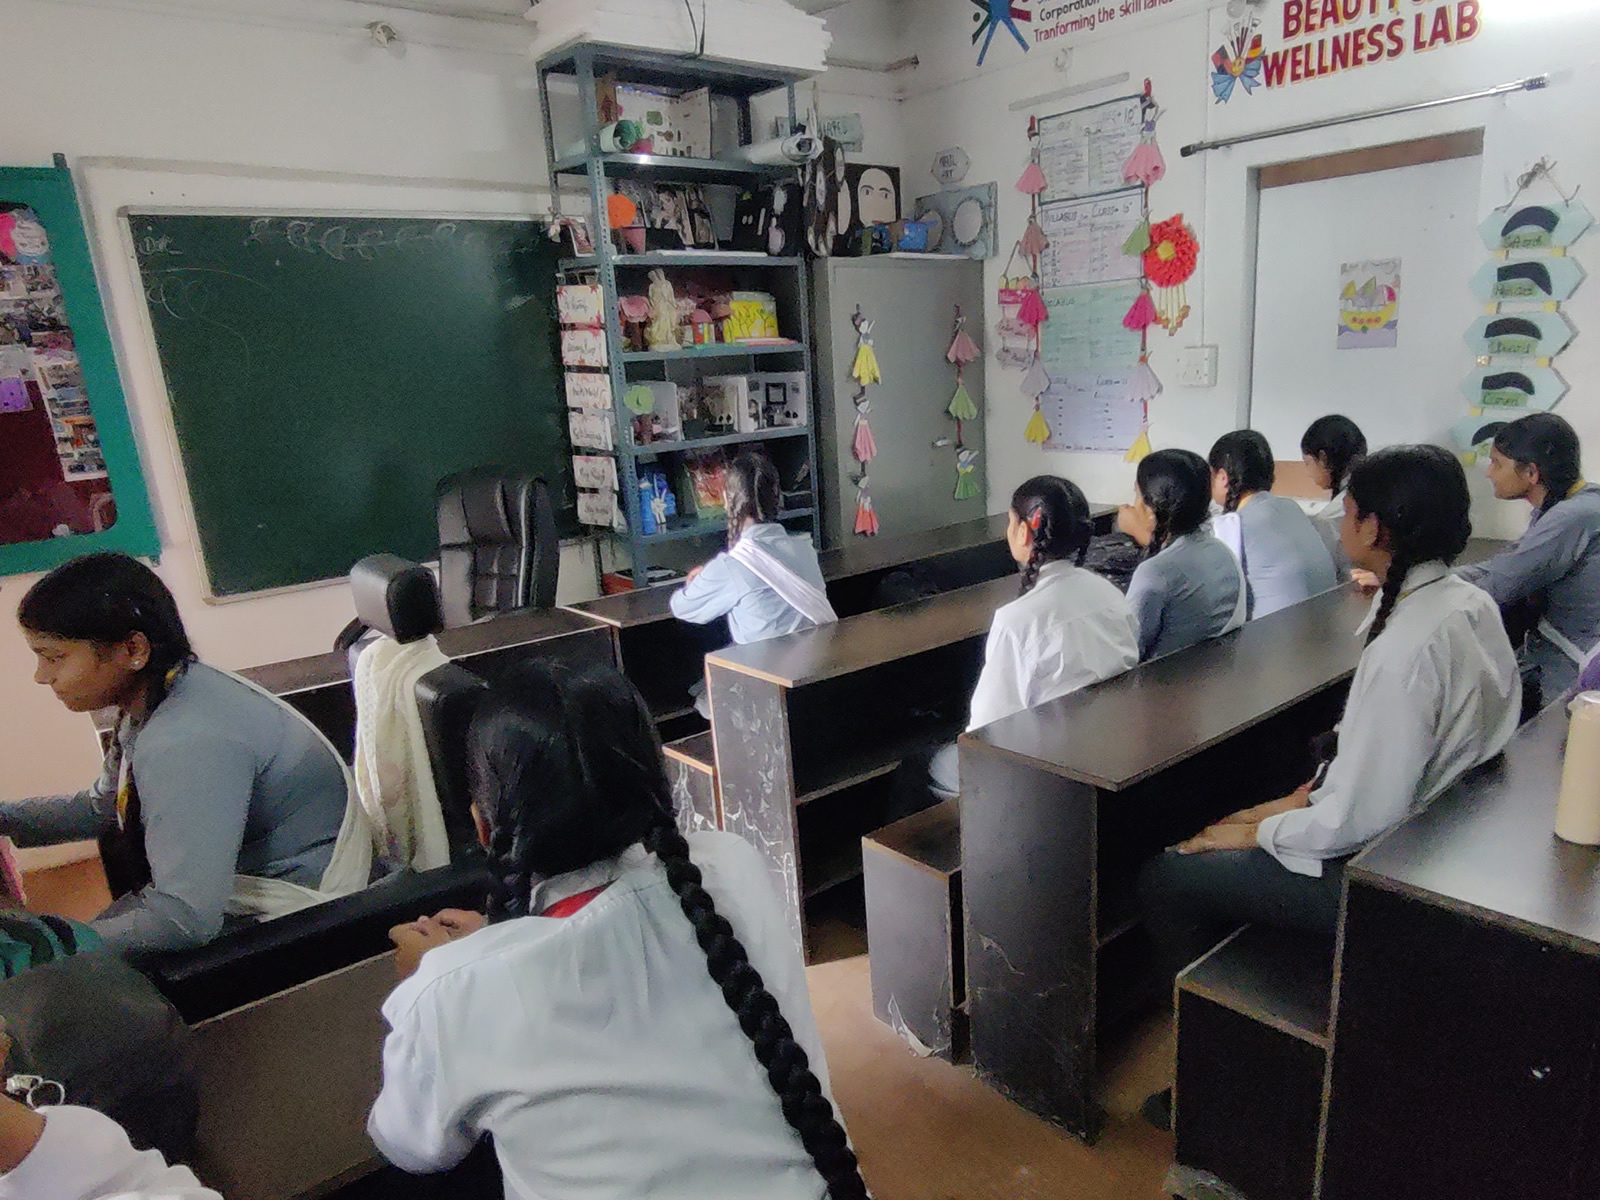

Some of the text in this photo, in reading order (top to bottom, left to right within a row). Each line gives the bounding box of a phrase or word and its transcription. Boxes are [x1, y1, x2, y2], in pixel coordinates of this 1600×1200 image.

[1034, 14, 1096, 42] Tranforming
[1097, 7, 1115, 23] the
[1119, 0, 1142, 18] skill
[1283, 0, 1398, 40] BEAU
[1263, 1, 1480, 88] WELLNESS LAB
